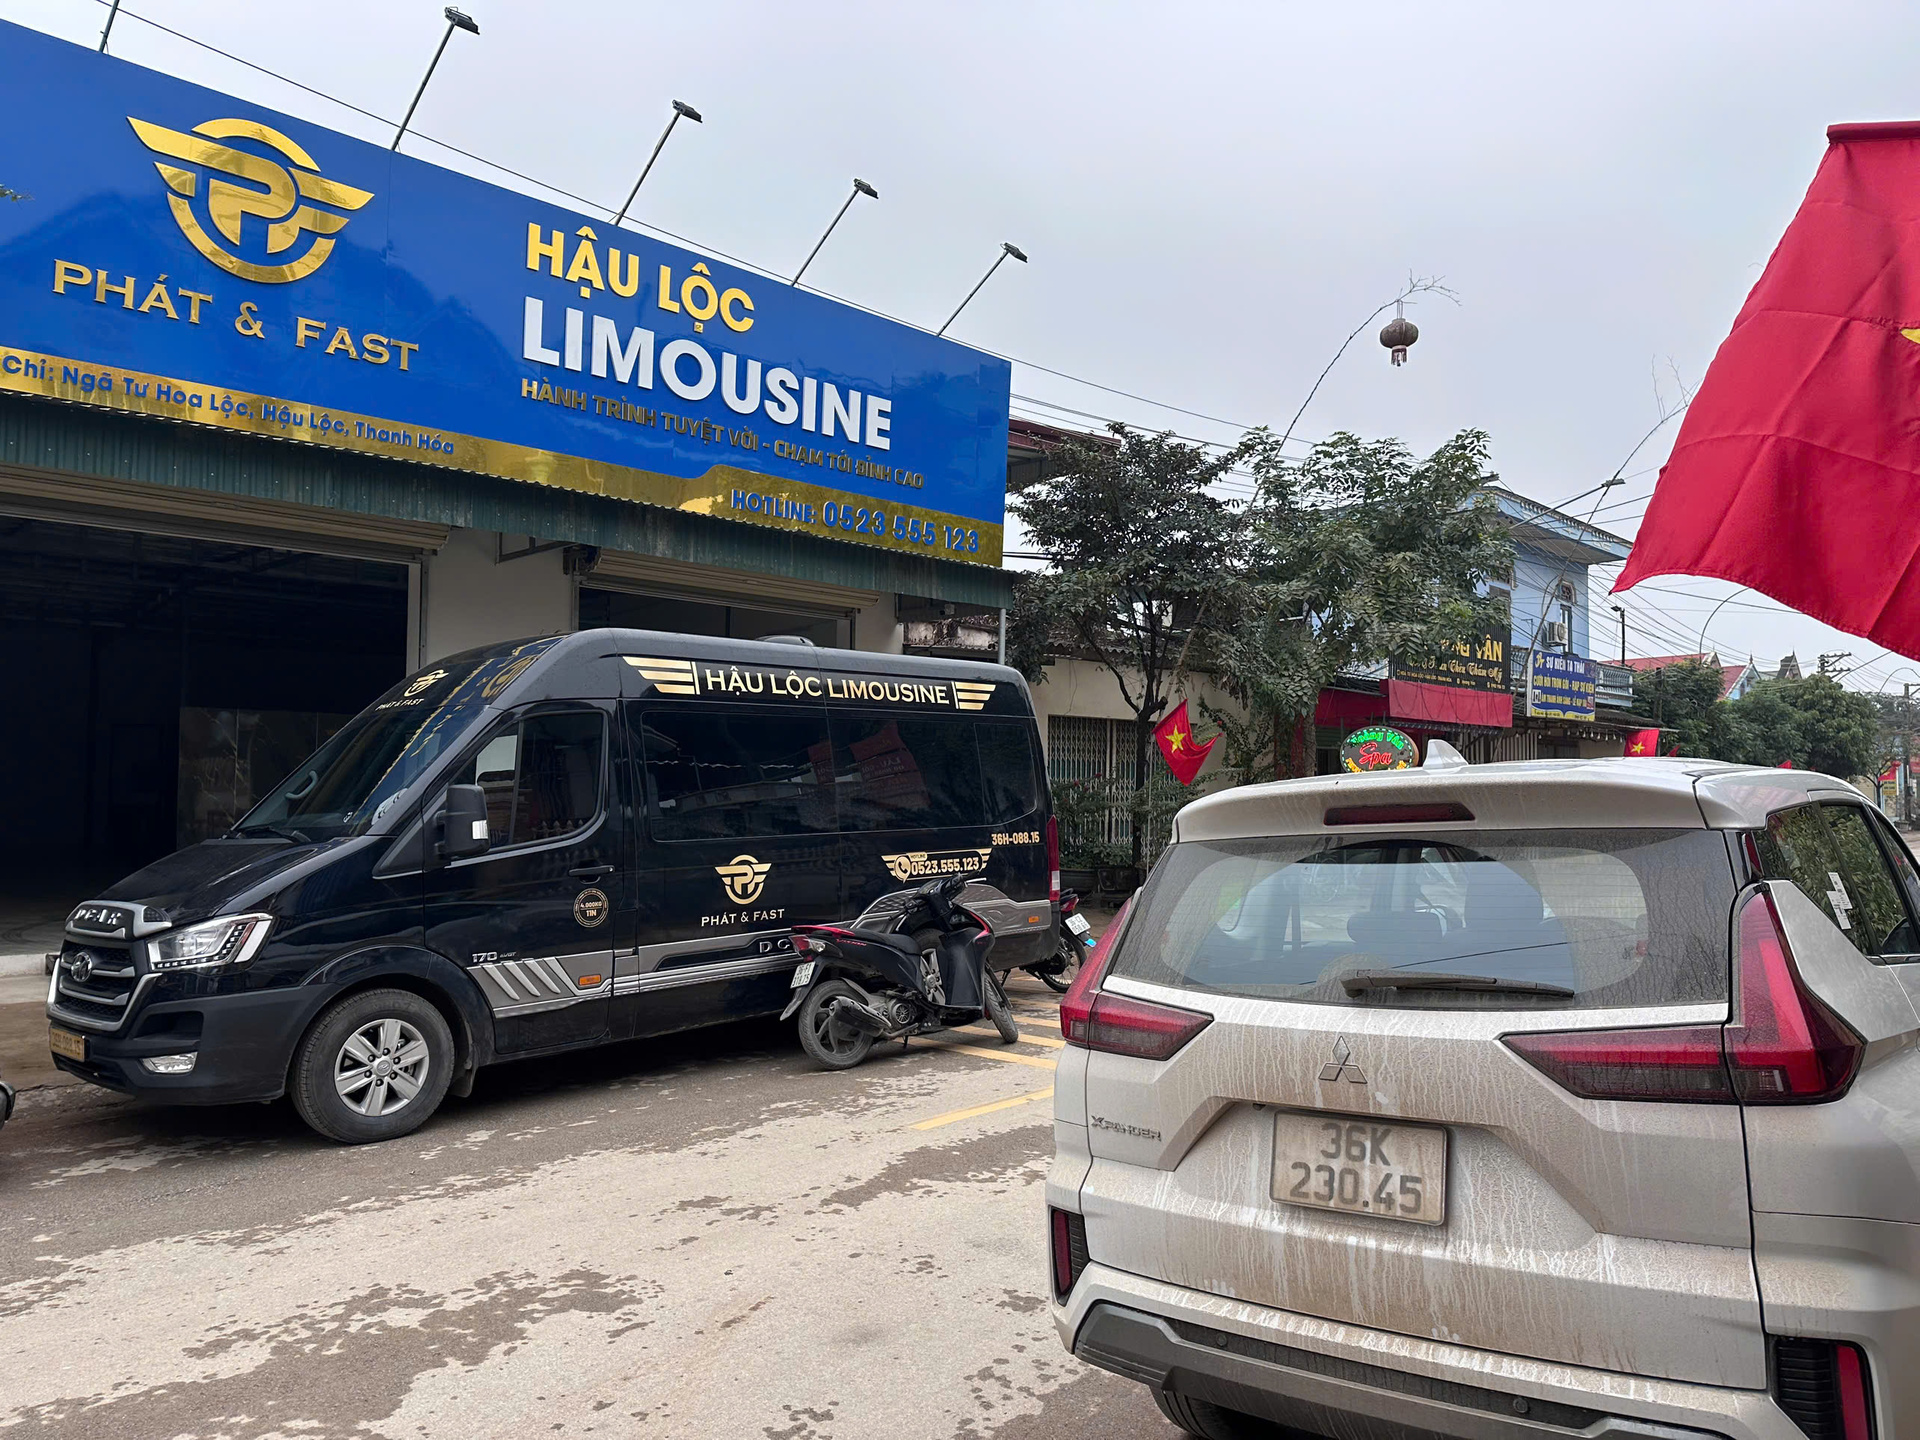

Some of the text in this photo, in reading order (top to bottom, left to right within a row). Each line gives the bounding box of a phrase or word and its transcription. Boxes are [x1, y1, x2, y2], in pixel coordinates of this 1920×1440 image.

[526, 222, 755, 333] HẬU LỘC
[52, 258, 419, 371] PHÁT & FAST
[522, 295, 892, 451] LIMOUSINE
[2, 355, 455, 455] Chỉ: Ngã Tư Hoa Lộc, Hậu Lộc, Thanh Hóa
[521, 376, 587, 411] HÀNH
[592, 395, 657, 427] TRÌNH
[661, 411, 725, 444] TUYỆT
[728, 425, 759, 451] VỜI
[773, 439, 823, 467] CHẠM
[827, 449, 852, 473] TỚI
[854, 454, 892, 482] ĐỈNH
[894, 468, 924, 489] CAO
[731, 488, 979, 553] HOTLINE: 0523 555 123
[703, 665, 950, 706] HẬU LỘC LIMOUSINE
[1359, 741, 1392, 769] Spa
[991, 831, 1040, 846] 36H-088.15
[911, 857, 980, 875] 0523.555.123
[701, 909, 785, 927] PHÁT & FAST
[472, 951, 497, 963] 170
[1091, 1115, 1162, 1142] XPANDER
[1320, 1122, 1391, 1166] 36K
[1289, 1161, 1423, 1214] 230.45
